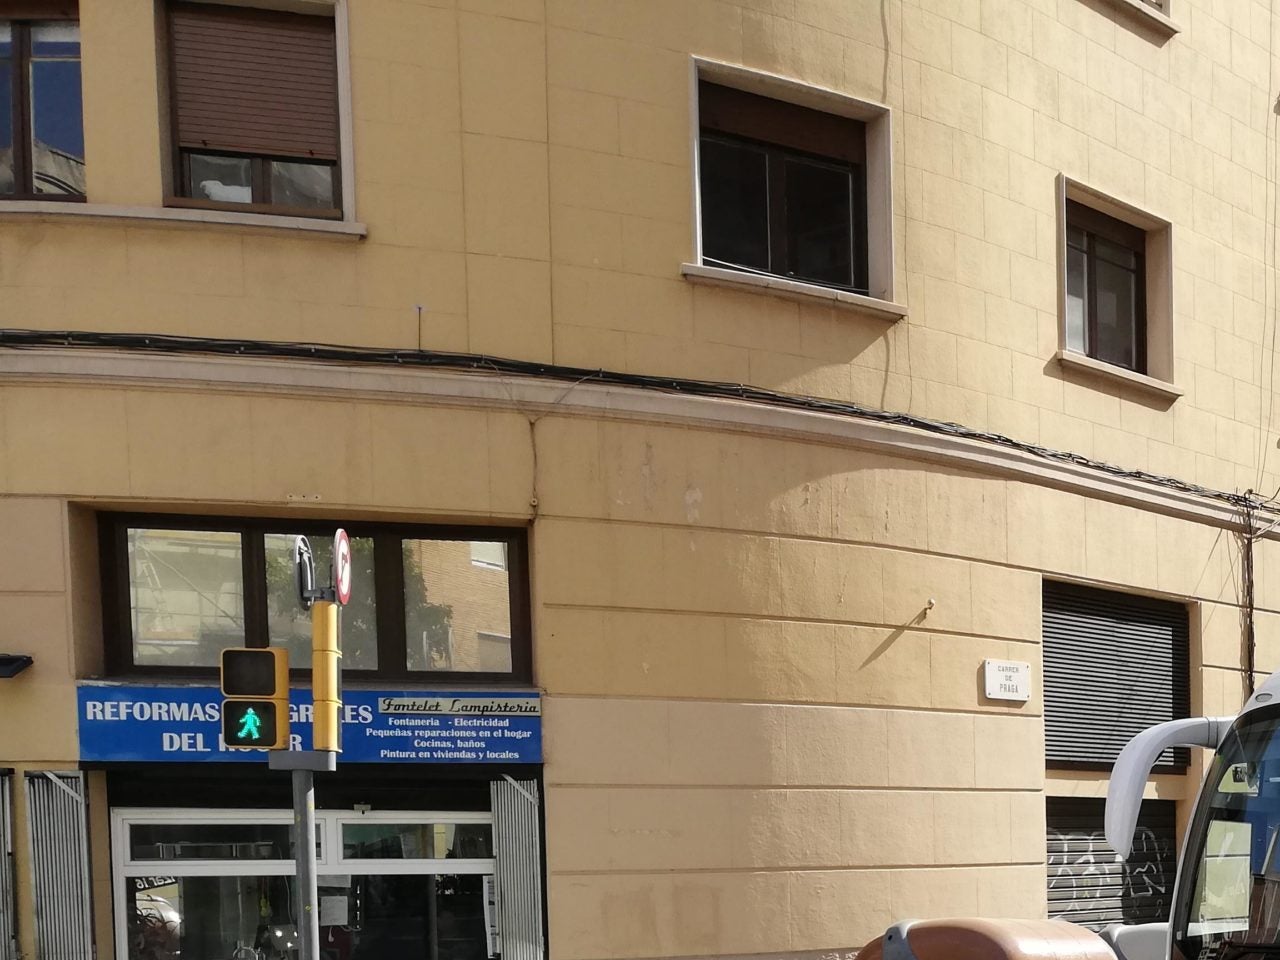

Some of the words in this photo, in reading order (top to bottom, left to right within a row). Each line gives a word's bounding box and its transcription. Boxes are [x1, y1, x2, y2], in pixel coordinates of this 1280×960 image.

[1000, 683, 1018, 693] PRAGA
[86, 701, 221, 722] REFORMAS
[454, 718, 510, 727] Electricidad
[365, 727, 413, 738] Pequeñas
[414, 728, 477, 738] reparaciones
[478, 730, 491, 738] en
[492, 729, 502, 738] el
[504, 730, 532, 739] hogar
[162, 732, 212, 752] DEL
[413, 738, 455, 749] Cocinas,
[457, 739, 486, 749] baños
[379, 749, 417, 759] Pintura
[418, 751, 431, 759] en
[432, 750, 477, 760] viviendas
[478, 752, 485, 760] y
[486, 750, 520, 760] locales
